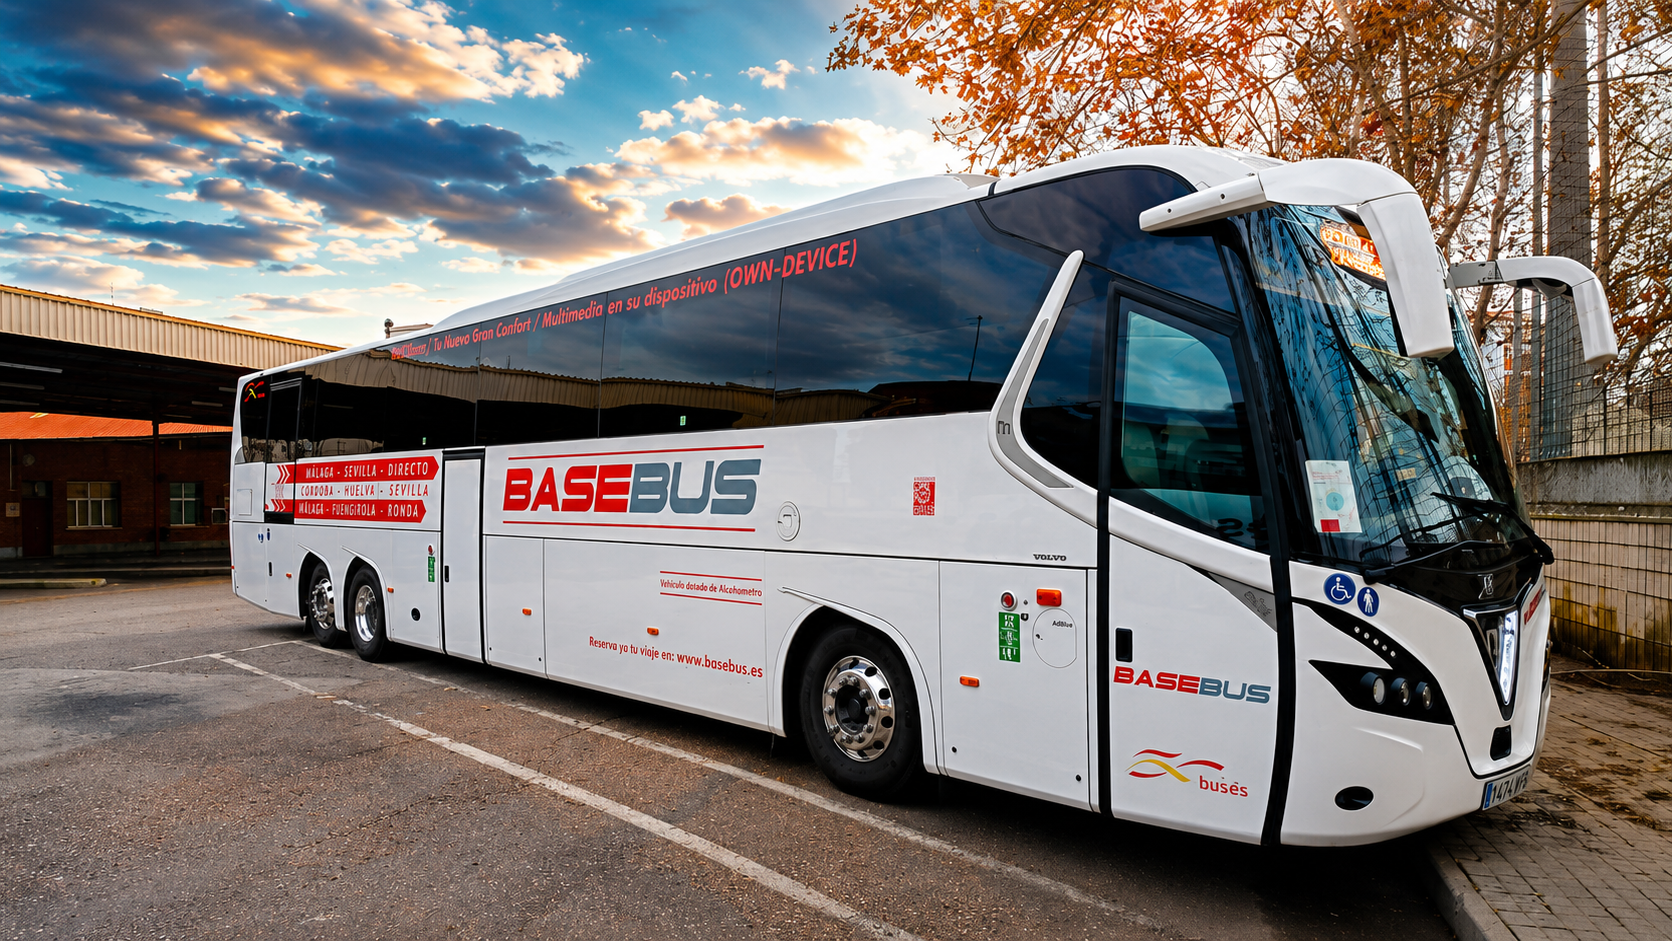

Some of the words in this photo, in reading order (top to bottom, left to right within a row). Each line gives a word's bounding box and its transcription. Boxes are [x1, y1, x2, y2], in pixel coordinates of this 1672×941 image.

[434, 338, 442, 351] Tu
[443, 334, 470, 349] Nuevo
[472, 328, 494, 343] Gran
[496, 317, 531, 338] Confort
[542, 300, 603, 328] Multimedia
[607, 299, 623, 315] en
[626, 294, 641, 311] su
[644, 276, 717, 308] dispositivo
[724, 238, 858, 294] (OWN-DEVICE)
[344, 465, 377, 478] SEVILLA
[388, 462, 429, 476] DIRECTO
[344, 484, 375, 497] HUELVA
[389, 483, 429, 497] SEVILLA
[502, 458, 762, 515] BASEBUS
[387, 504, 419, 518] RONDA
[1033, 554, 1067, 562] VOLVO
[686, 581, 708, 592] dotado
[709, 583, 717, 593] de
[1052, 620, 1073, 628] AdBlue
[589, 635, 618, 651] Reserva
[630, 643, 638, 655] tu
[640, 644, 659, 661] viaje
[661, 651, 675, 662] en:
[677, 652, 764, 678] www.basebus.es
[1113, 665, 1272, 704] BASEBUS
